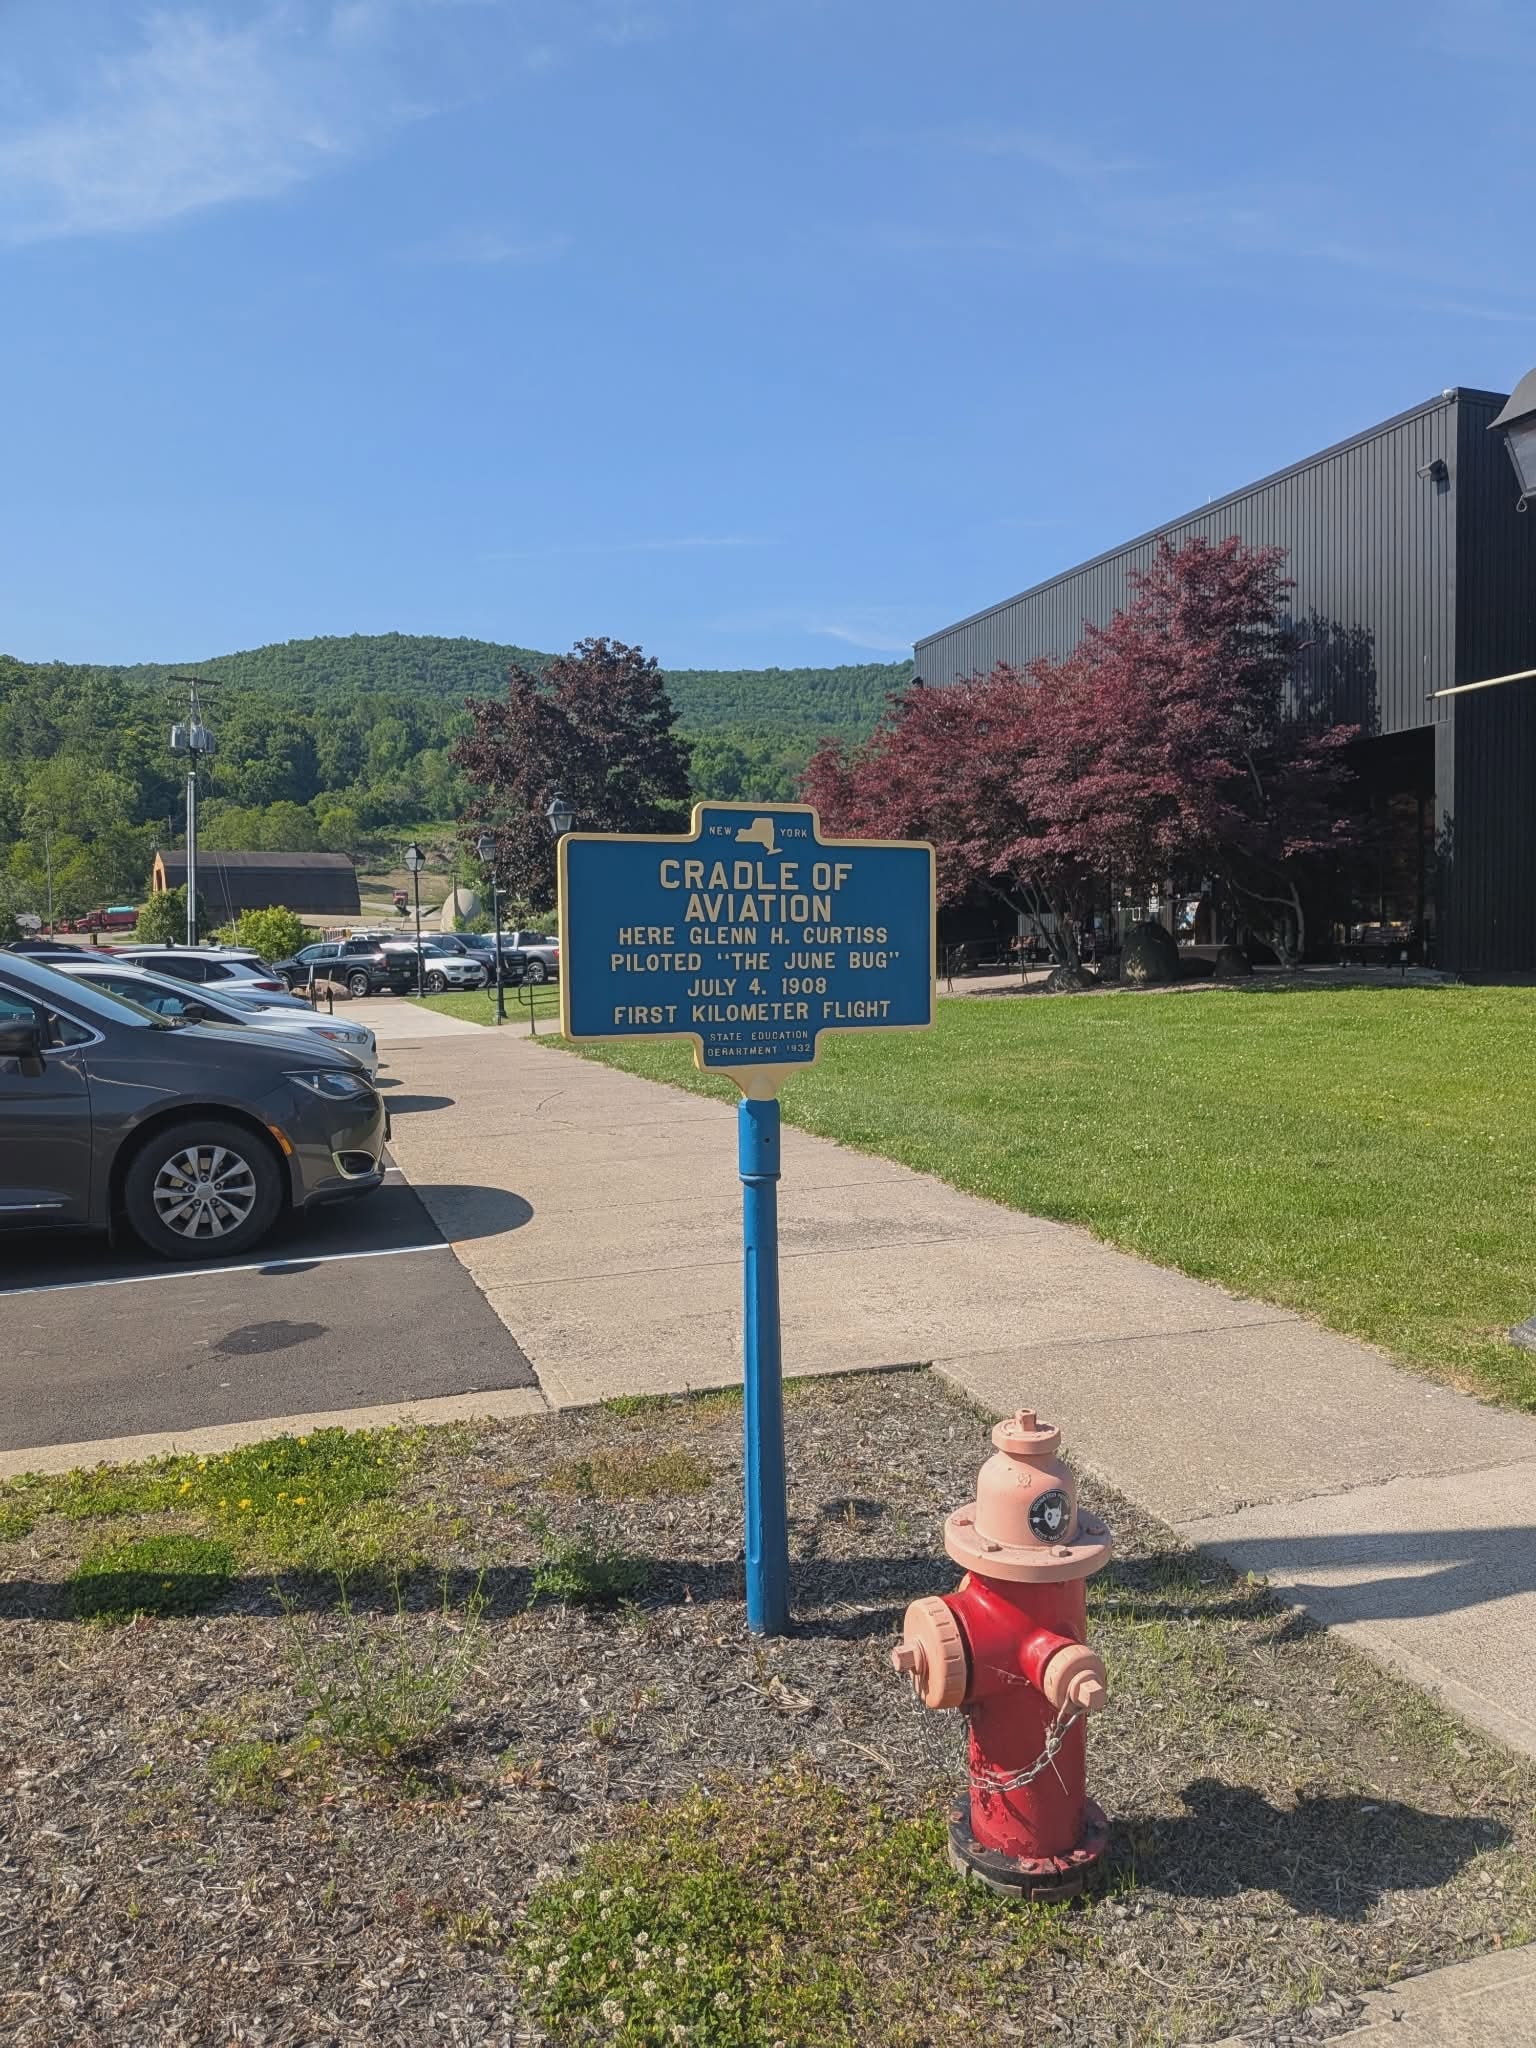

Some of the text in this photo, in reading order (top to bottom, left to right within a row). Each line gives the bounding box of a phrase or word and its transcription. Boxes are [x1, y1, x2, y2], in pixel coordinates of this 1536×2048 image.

[709, 826, 808, 838] NEW YORK
[660, 859, 853, 891] CRADLE OF
[684, 893, 831, 923] AVIATION
[619, 926, 888, 945] HERE GLENN H. CURTISS
[611, 954, 702, 972] PILOTED
[784, 952, 836, 970] JUNE
[687, 979, 737, 997] JULY
[781, 977, 827, 995] 1908
[614, 1001, 891, 1025] FIRST KILOMETER FLIGHT
[710, 1030, 808, 1041] STATE EDUCATION
